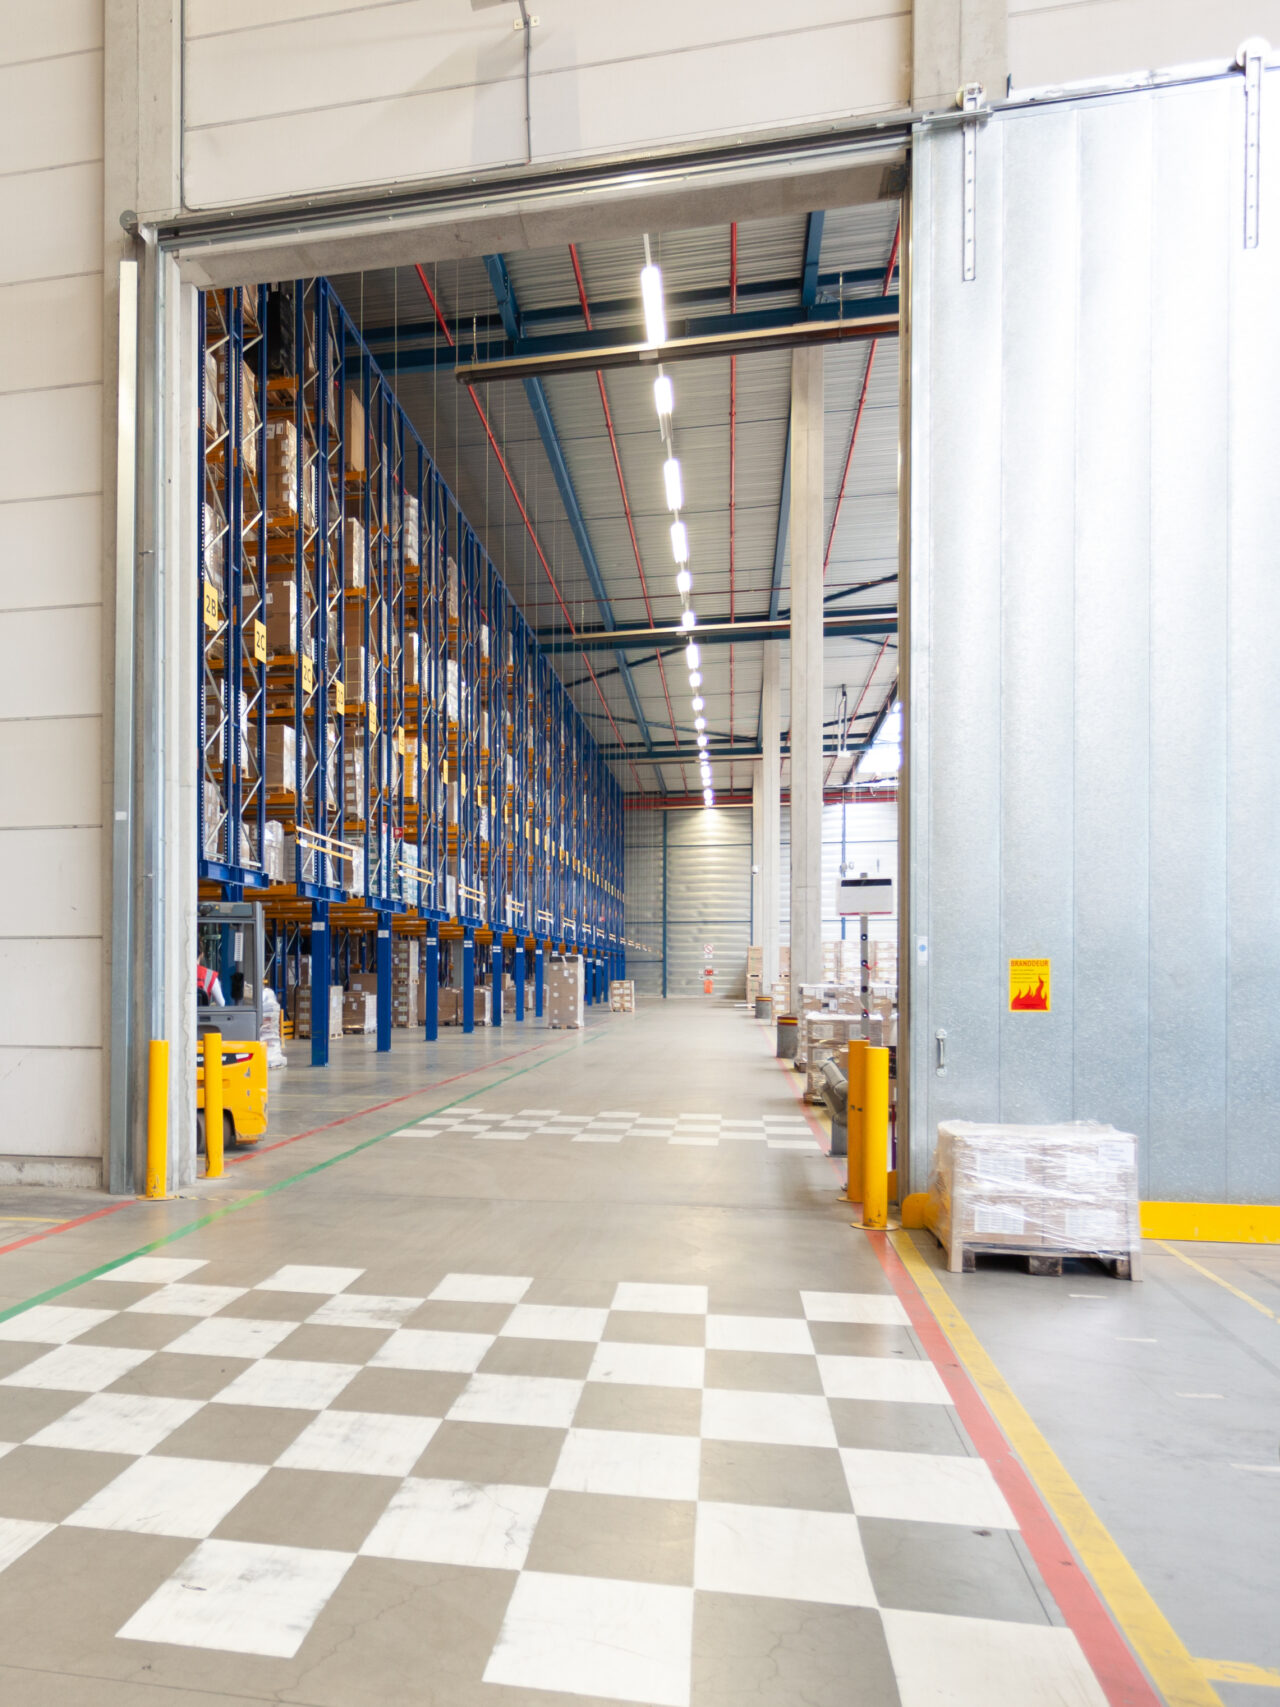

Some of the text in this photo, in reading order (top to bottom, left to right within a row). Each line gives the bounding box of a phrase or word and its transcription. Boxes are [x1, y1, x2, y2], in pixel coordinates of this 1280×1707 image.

[205, 594, 217, 617] 2B
[256, 631, 265, 651] 2C
[303, 664, 312, 684] 2C
